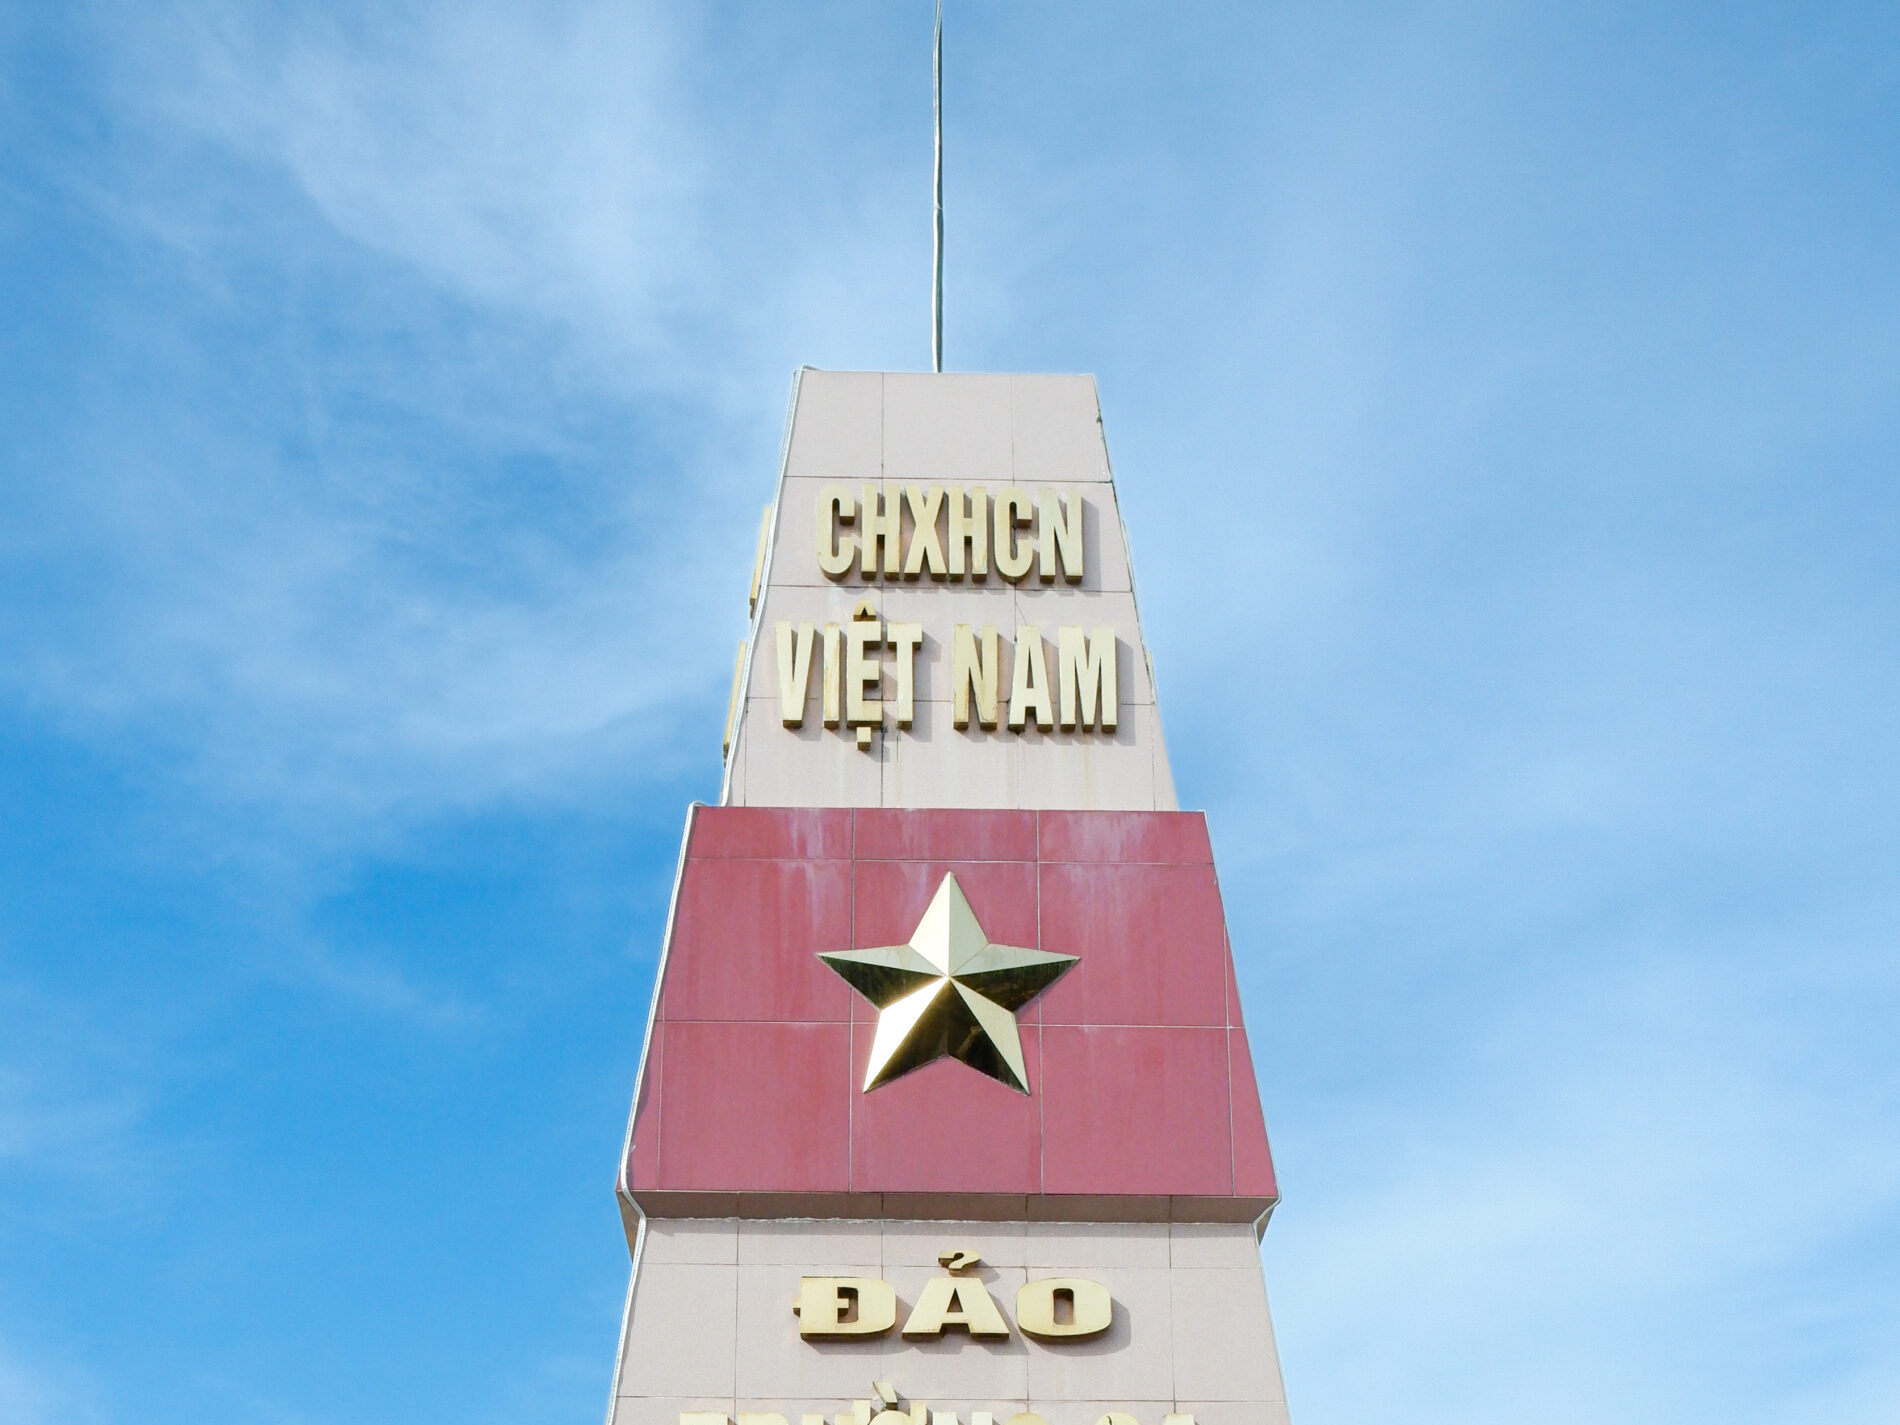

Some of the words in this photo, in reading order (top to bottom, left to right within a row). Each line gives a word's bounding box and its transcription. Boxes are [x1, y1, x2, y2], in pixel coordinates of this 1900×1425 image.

[816, 483, 1084, 584] CHXHCN
[775, 599, 923, 751] VIỆT
[953, 624, 1118, 733] NAM
[793, 1248, 1113, 1340] ĐẢO
